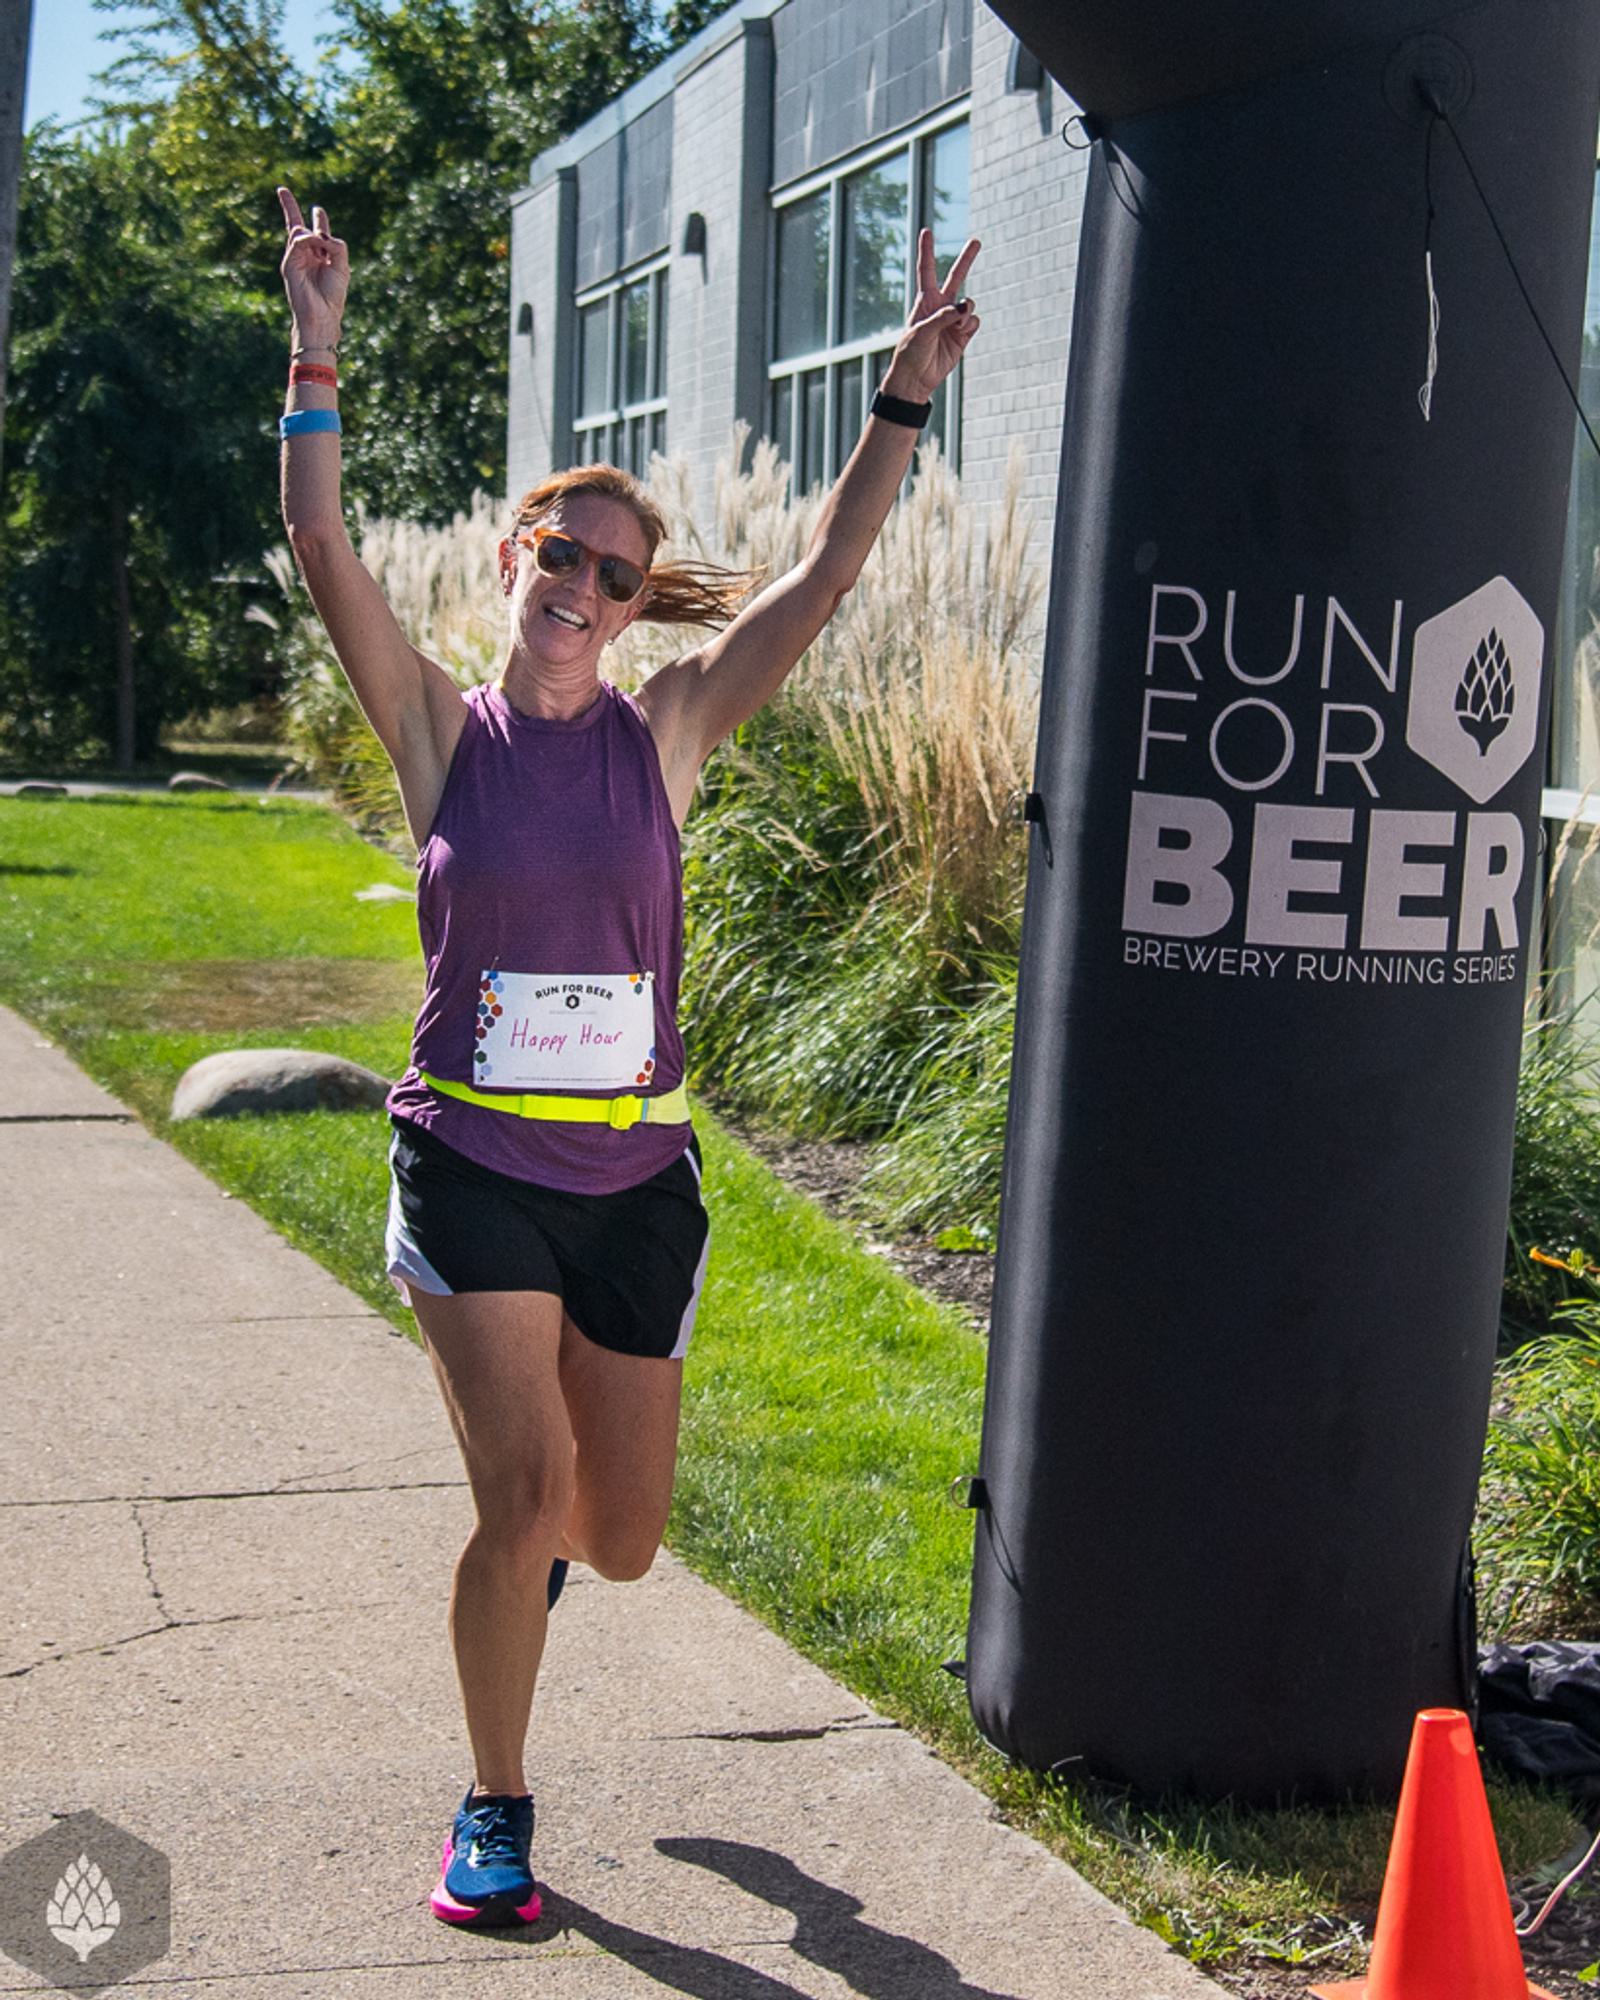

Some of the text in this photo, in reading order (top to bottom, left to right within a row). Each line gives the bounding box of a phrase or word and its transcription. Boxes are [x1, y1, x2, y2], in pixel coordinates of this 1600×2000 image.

[1144, 583, 1404, 693] RUN
[1137, 688, 1386, 799] FOR
[1121, 790, 1525, 951] BEER
[535, 984, 613, 1000] RUN FOR BEER
[1123, 937, 1516, 984] BREWERY RUNNING SERIES
[510, 1018, 623, 1054] Happy Hour
